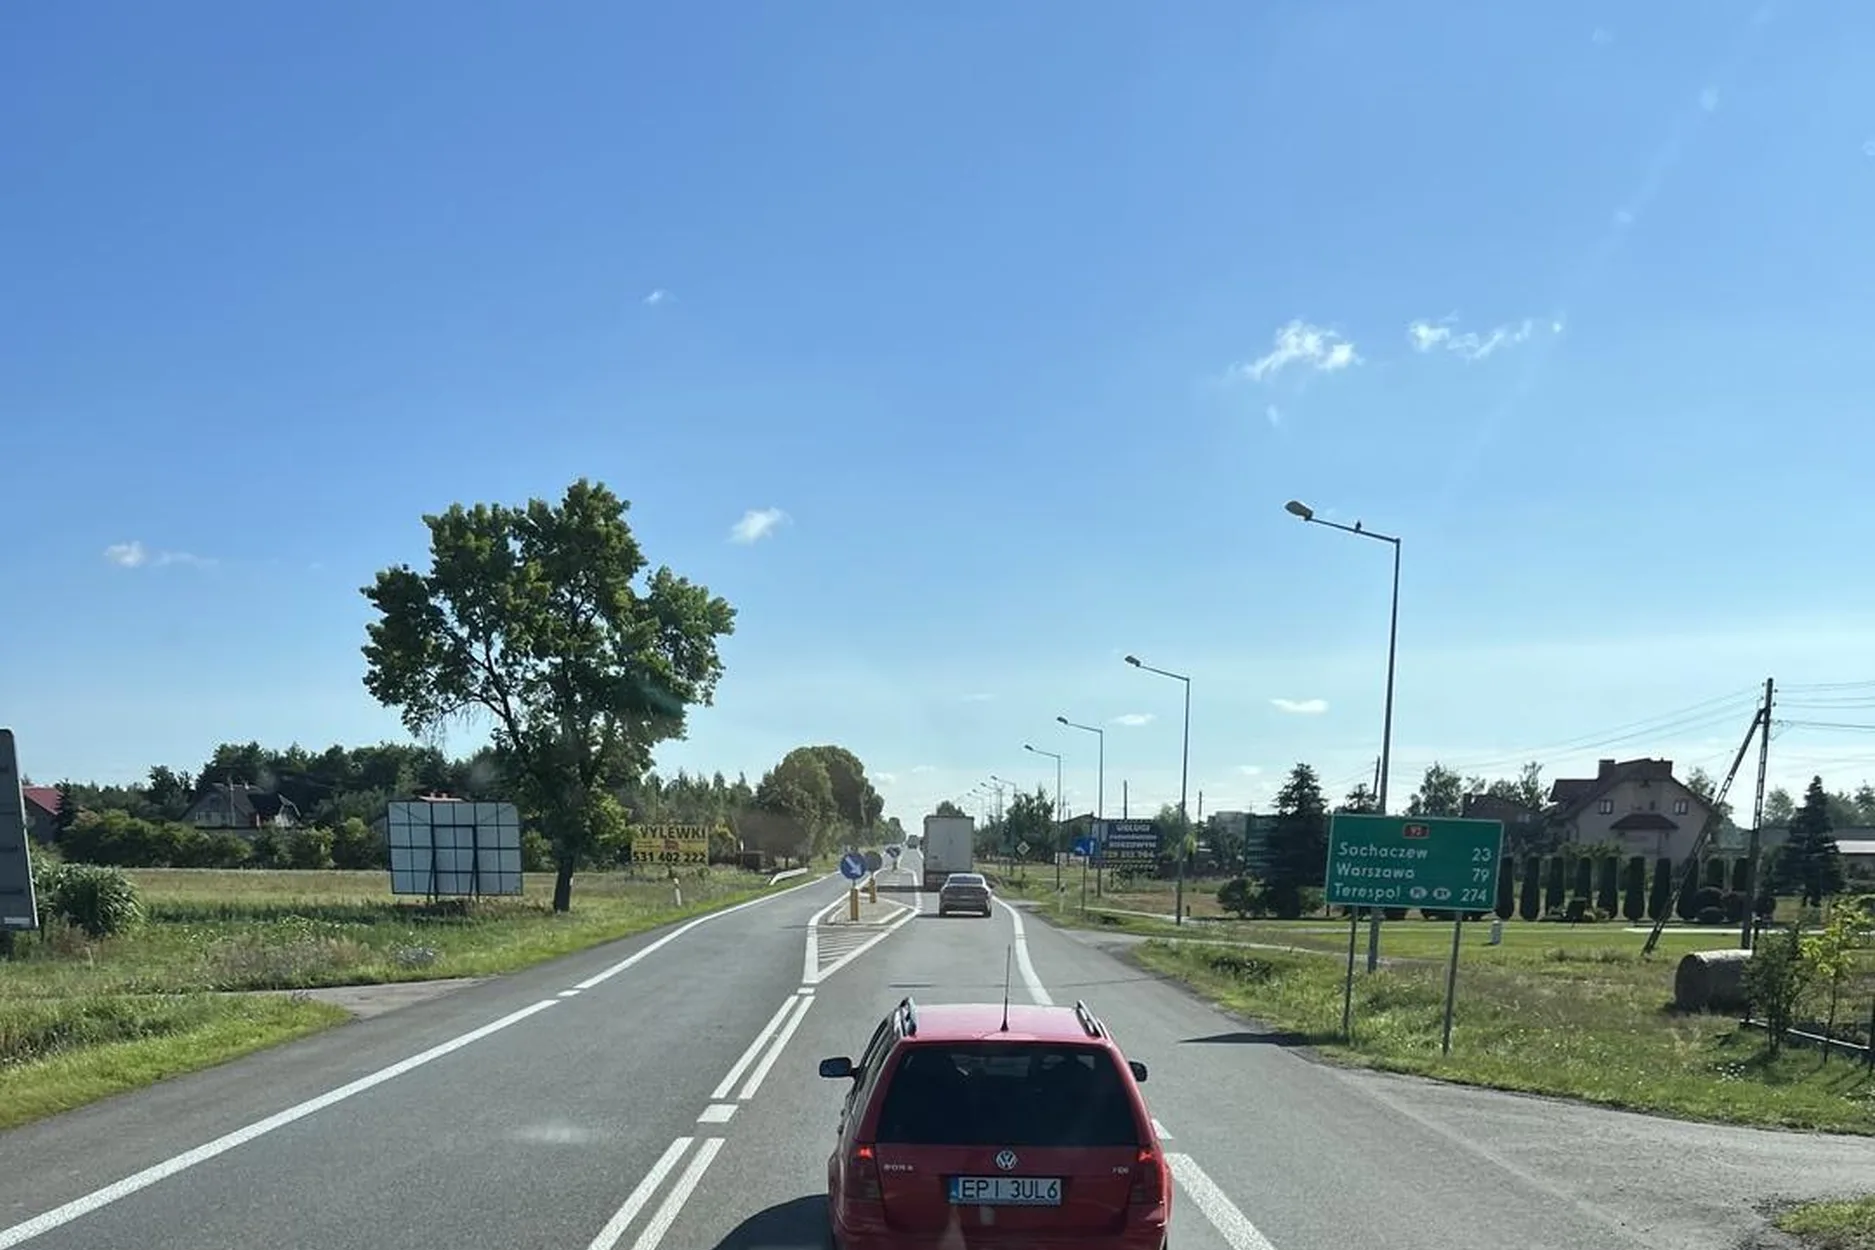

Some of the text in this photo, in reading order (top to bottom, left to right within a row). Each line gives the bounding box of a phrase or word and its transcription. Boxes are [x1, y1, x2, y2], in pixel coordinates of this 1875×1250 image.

[1339, 842, 1492, 862] Sochaczew 23
[1336, 862, 1489, 882] Warszawa 79
[1334, 882, 1400, 901] Terespol
[1461, 888, 1487, 902] 274
[1010, 1180, 1058, 1199] 3UL6
